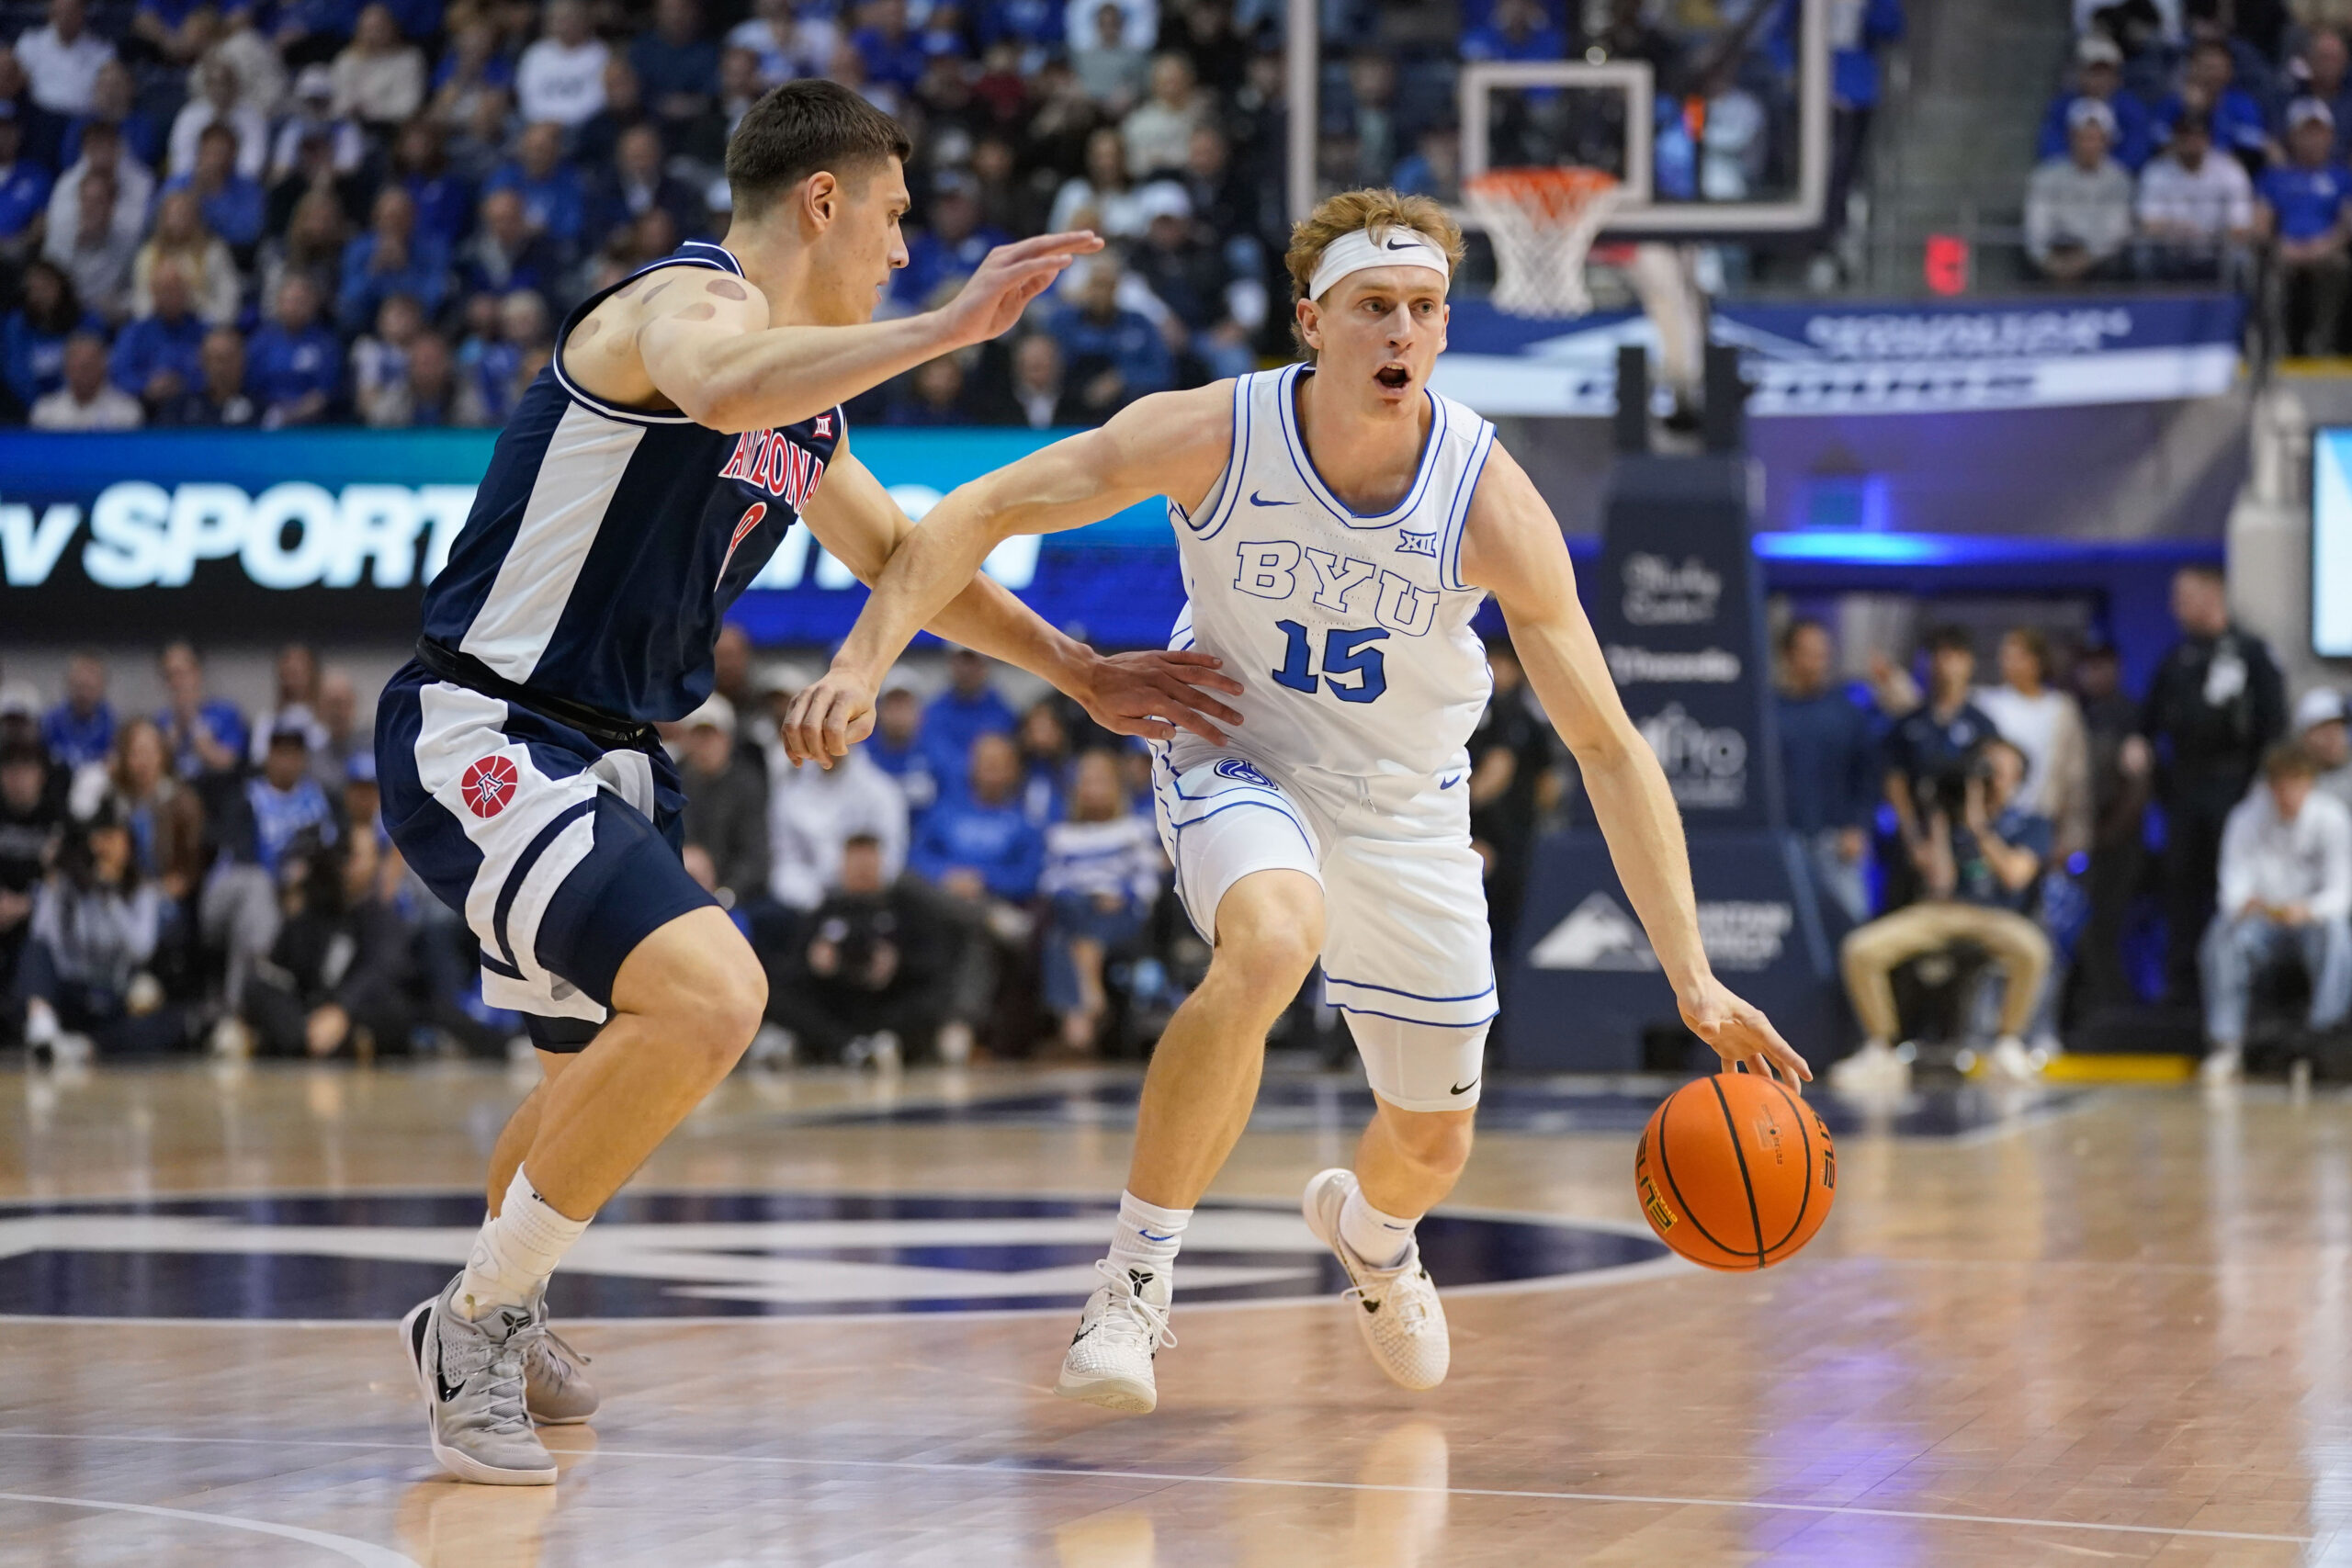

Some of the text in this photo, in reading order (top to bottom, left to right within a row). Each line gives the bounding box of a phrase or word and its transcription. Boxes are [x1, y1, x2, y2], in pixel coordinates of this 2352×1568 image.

[718, 428, 824, 516] AIZONA
[1396, 529, 1437, 558] XII
[1233, 540, 1440, 637] BYU
[1272, 619, 1391, 704] 15
